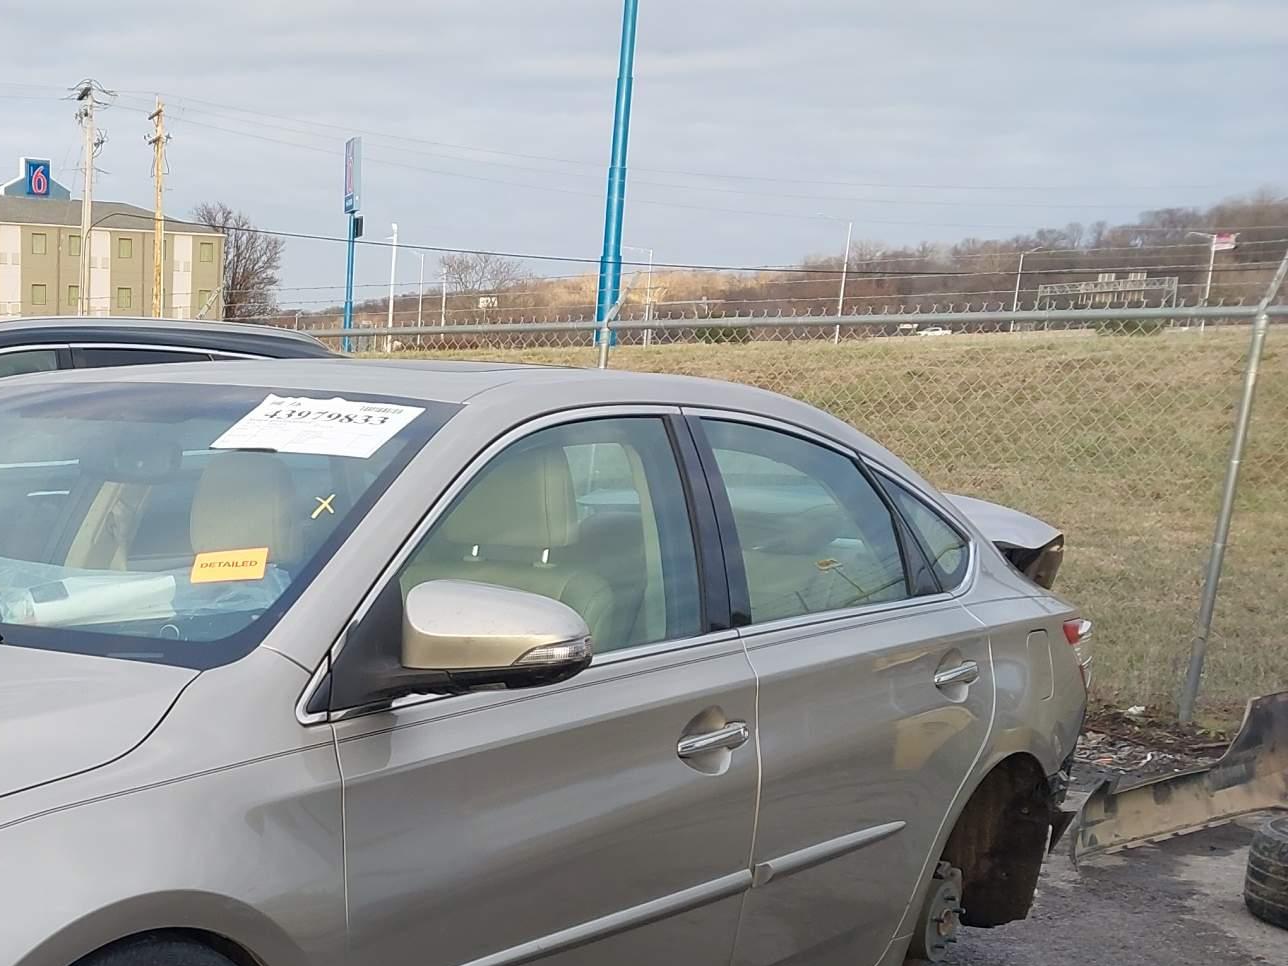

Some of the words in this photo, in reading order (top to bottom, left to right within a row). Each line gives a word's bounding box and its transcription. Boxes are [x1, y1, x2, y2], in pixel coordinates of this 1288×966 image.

[32, 165, 48, 194] 6
[264, 409, 391, 426] 43979833
[199, 560, 259, 569] DETAILED
